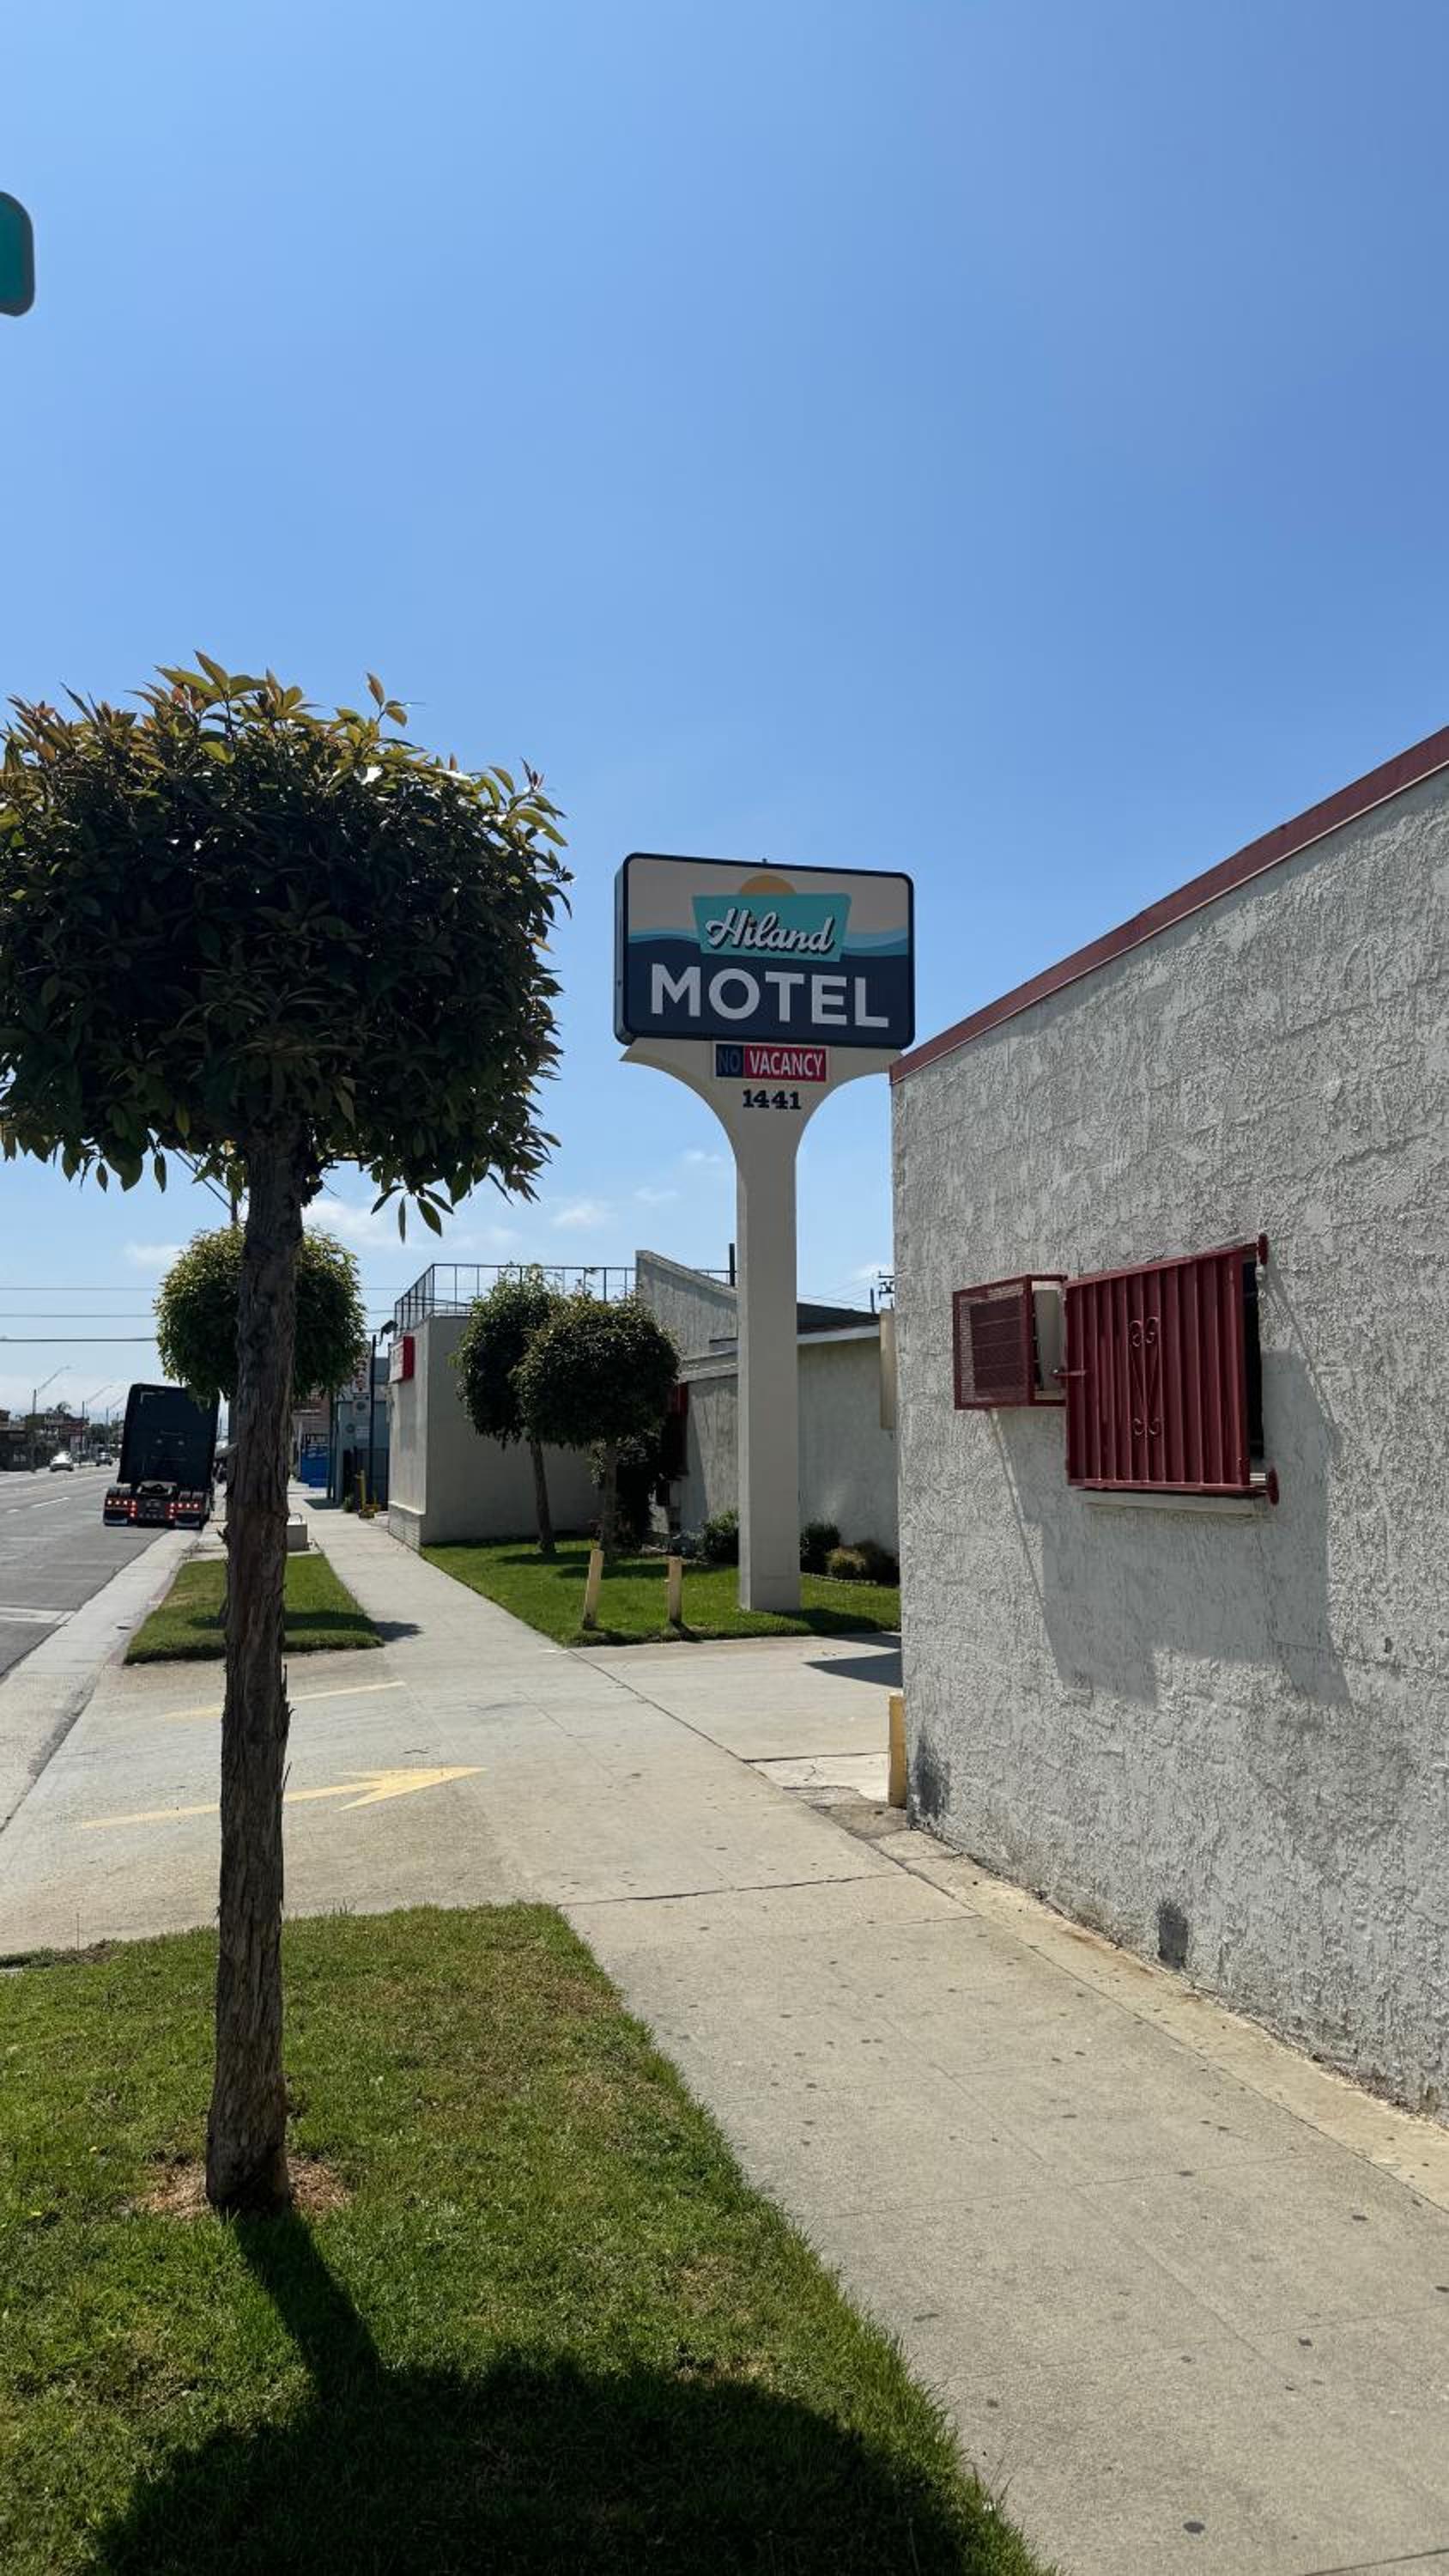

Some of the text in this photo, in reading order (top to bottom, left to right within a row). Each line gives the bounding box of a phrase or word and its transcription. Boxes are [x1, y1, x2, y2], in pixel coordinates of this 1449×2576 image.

[705, 908, 834, 953] Hiland
[651, 963, 889, 1028] MOTEL
[718, 1049, 823, 1076] NO VACANCY
[743, 1089, 802, 1110] 1441
